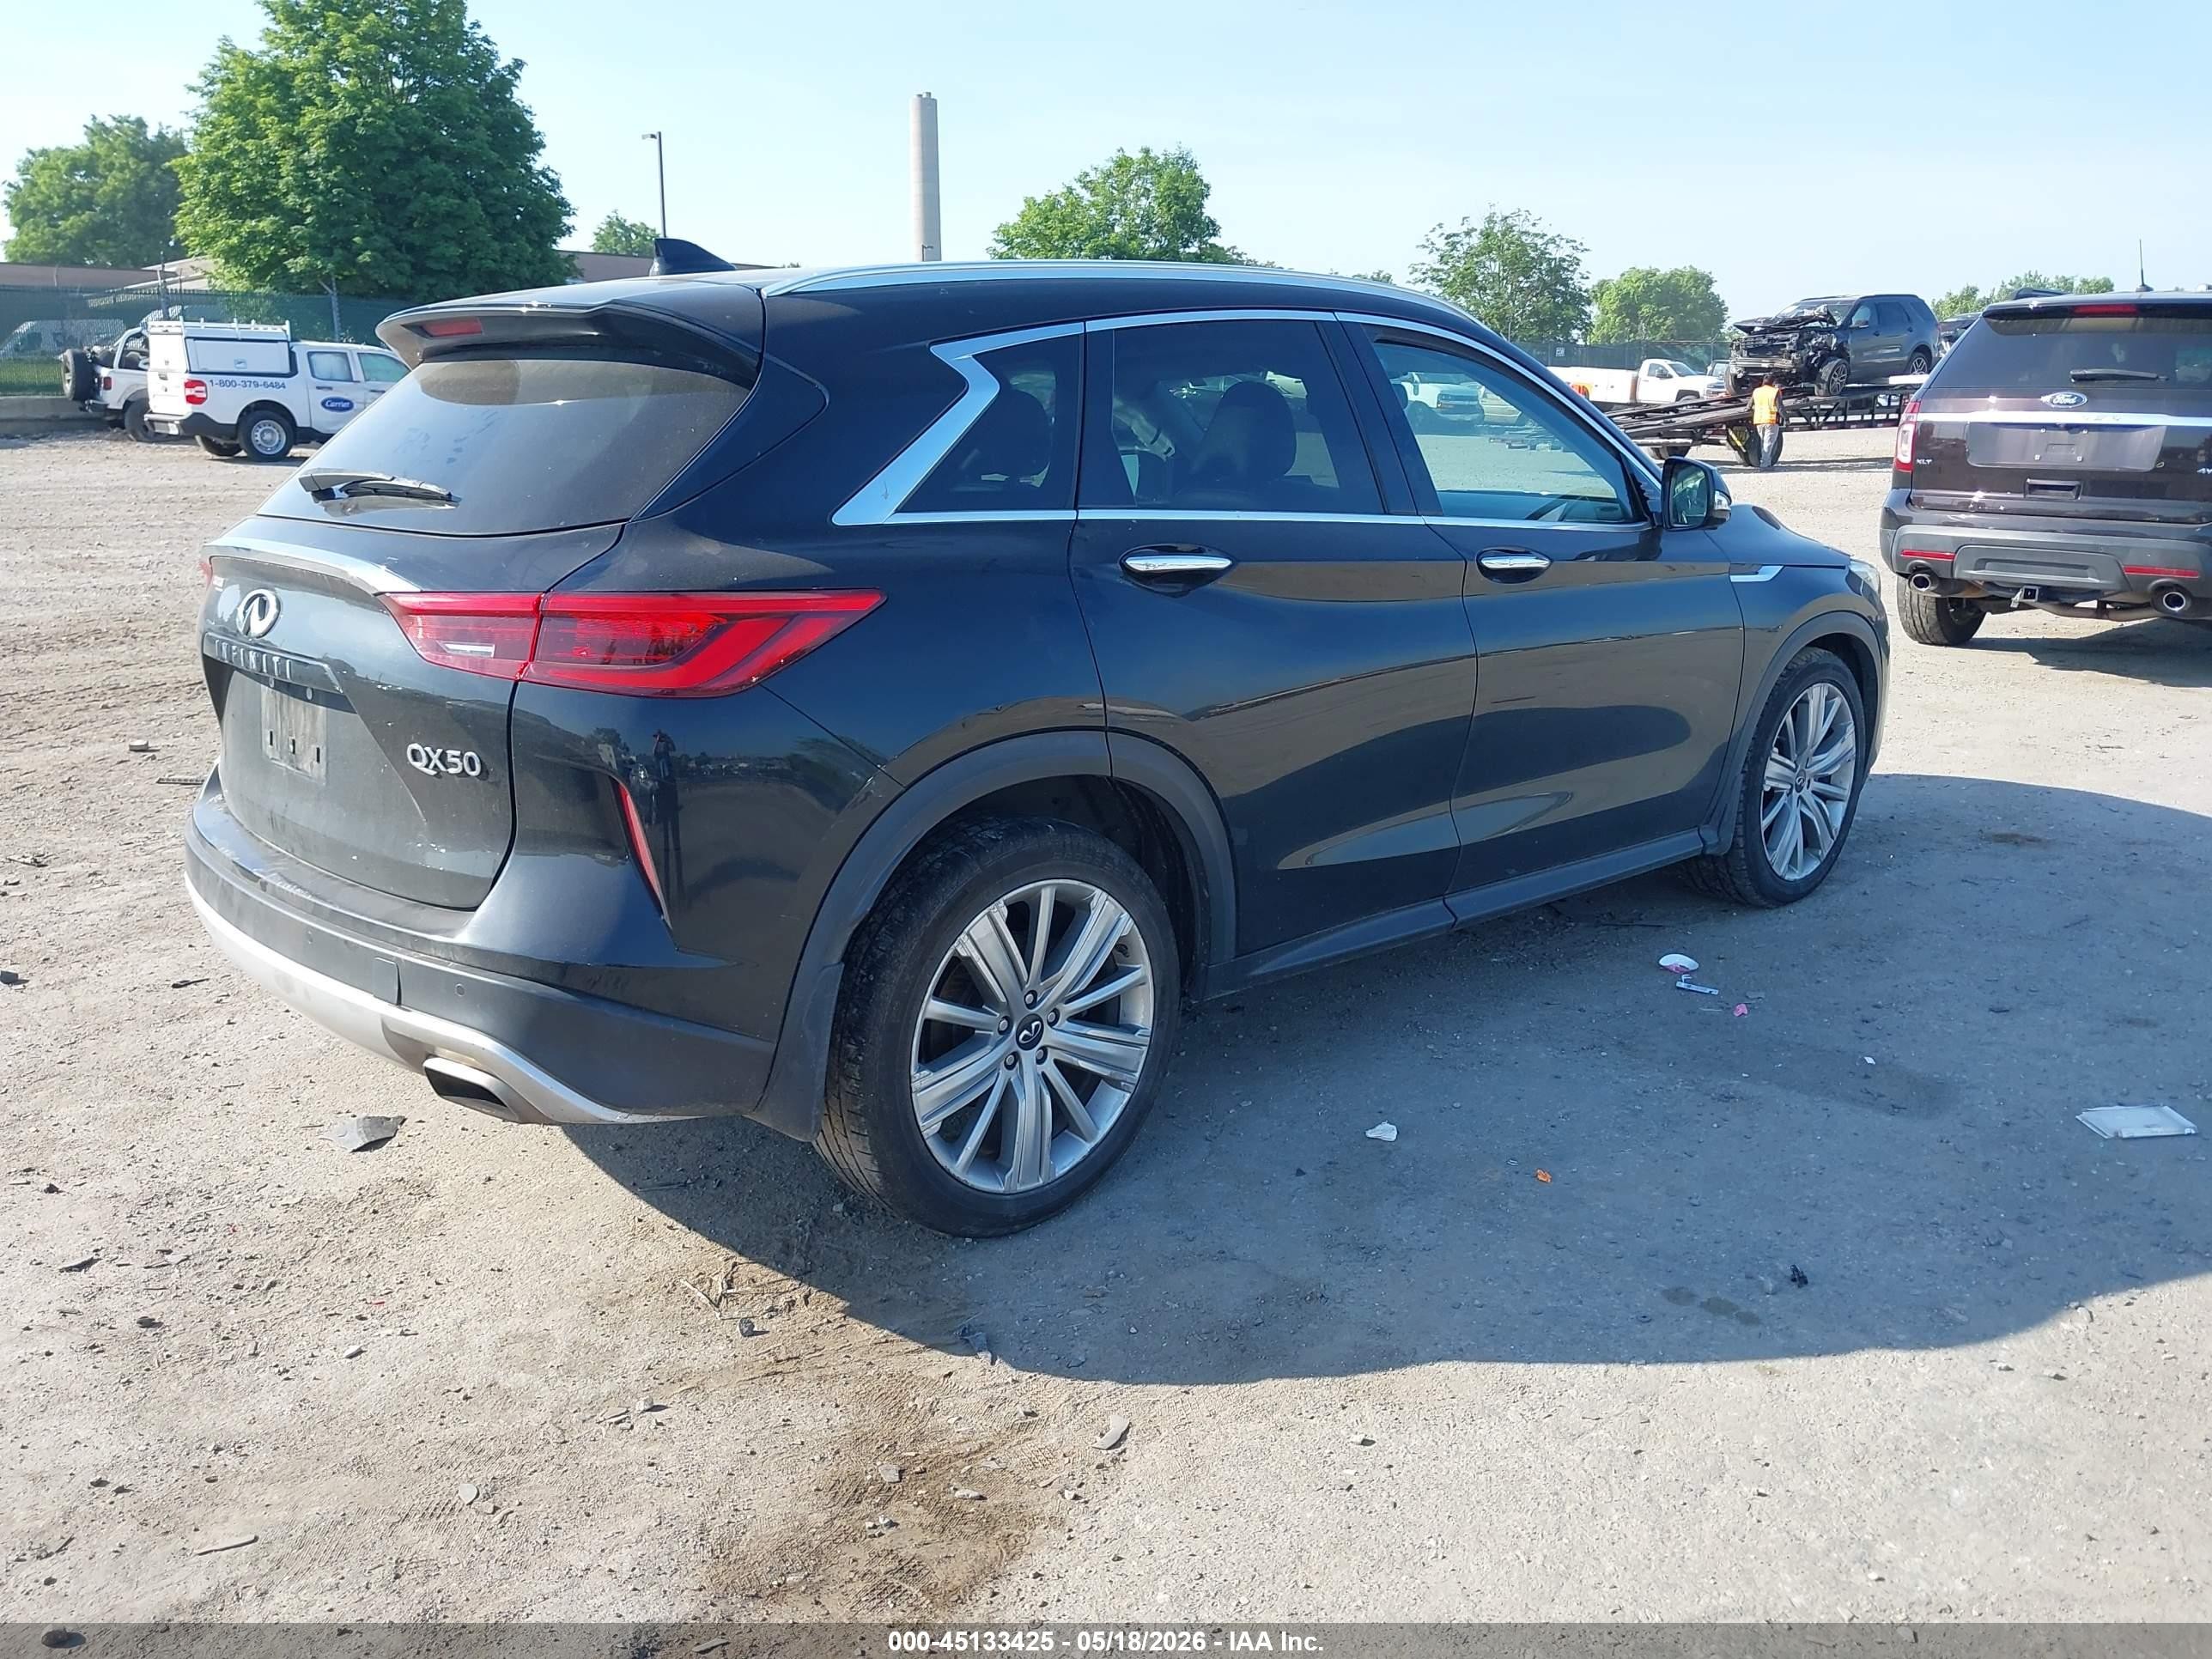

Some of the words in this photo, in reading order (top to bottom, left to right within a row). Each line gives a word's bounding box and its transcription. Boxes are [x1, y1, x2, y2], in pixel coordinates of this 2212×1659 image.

[210, 380, 286, 389] 1-800-379-6484
[2053, 394, 2078, 404] Ford
[215, 639, 292, 681] INFINITI
[406, 743, 482, 776] QX50
